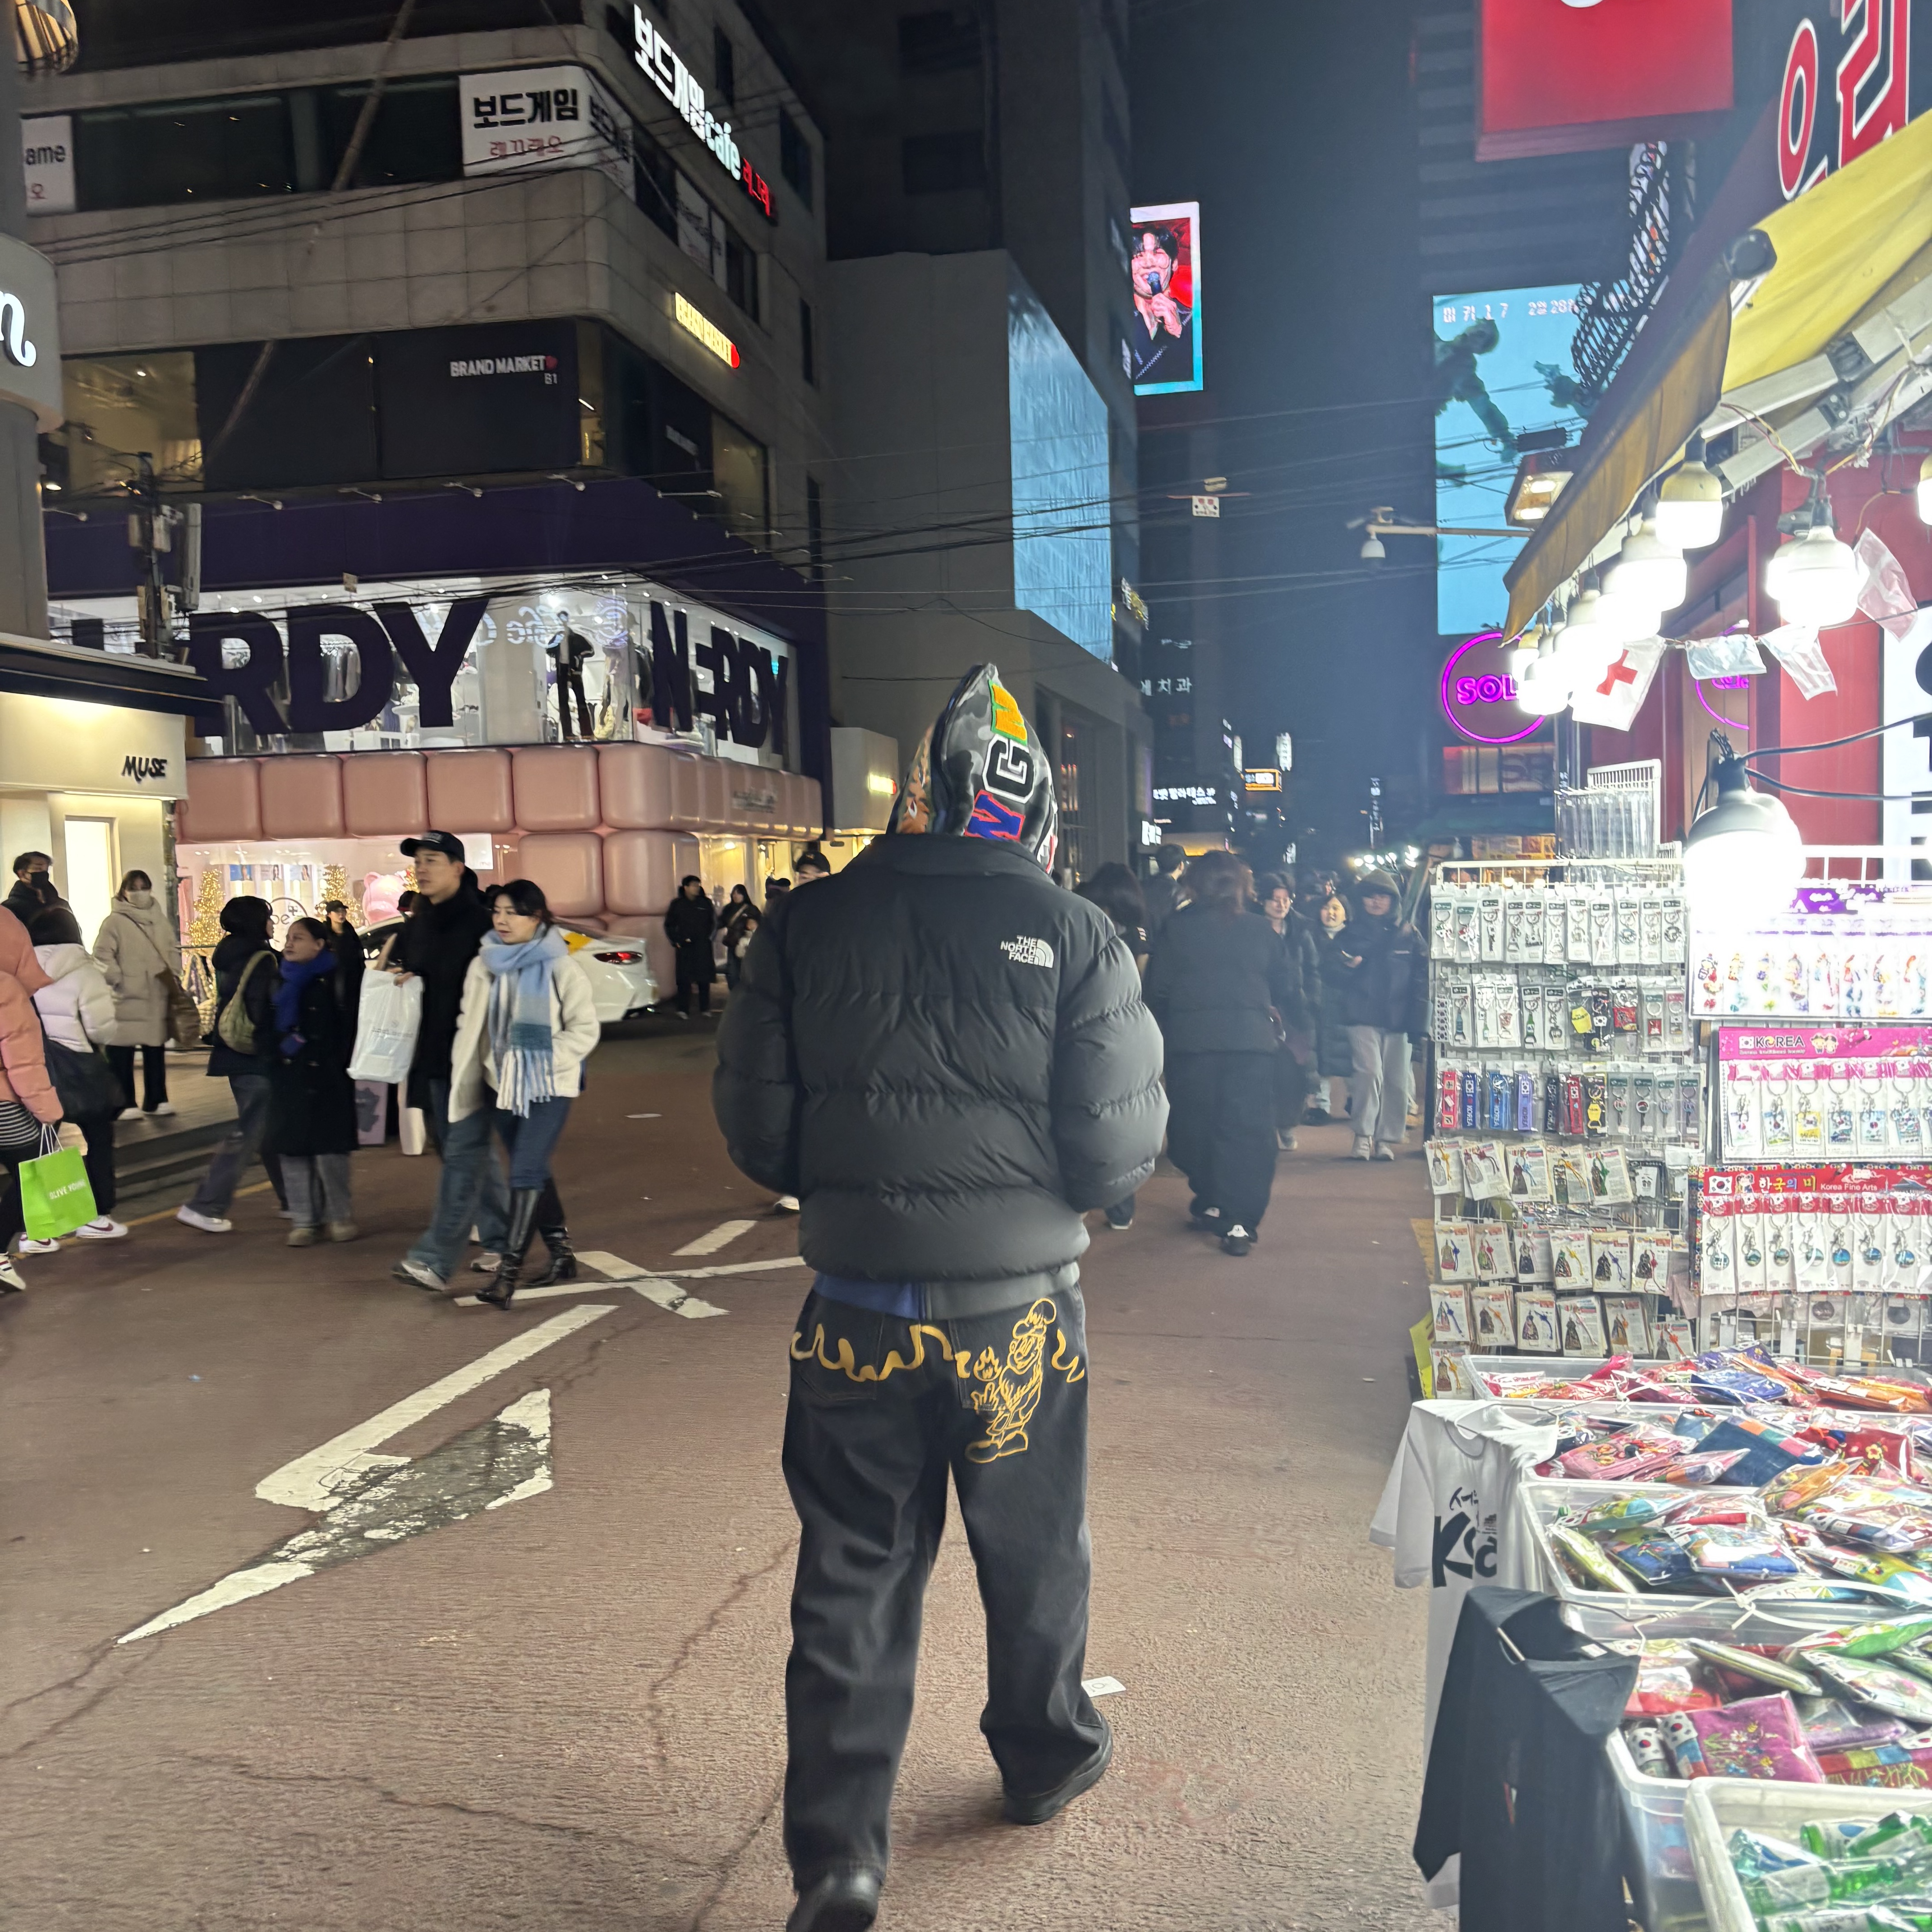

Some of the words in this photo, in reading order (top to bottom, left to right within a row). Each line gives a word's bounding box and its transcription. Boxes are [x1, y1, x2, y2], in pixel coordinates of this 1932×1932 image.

[474, 88, 579, 129] 보드게임
[25, 145, 66, 165] ame
[450, 359, 495, 377] BRAND
[495, 355, 546, 373] MARKET
[544, 373, 557, 384] B1
[650, 601, 789, 755] NERDY
[1456, 674, 1519, 705] SOL
[121, 755, 168, 782] MUSE
[1000, 940, 1036, 956] NORTH
[1017, 935, 1037, 946] THE
[1008, 952, 1035, 964] FACE
[1756, 1035, 1805, 1048] KOREA
[49, 1186, 67, 1200] OLIVE
[1759, 1176, 1797, 1194] 한국의
[1821, 1183, 1842, 1191] Korea
